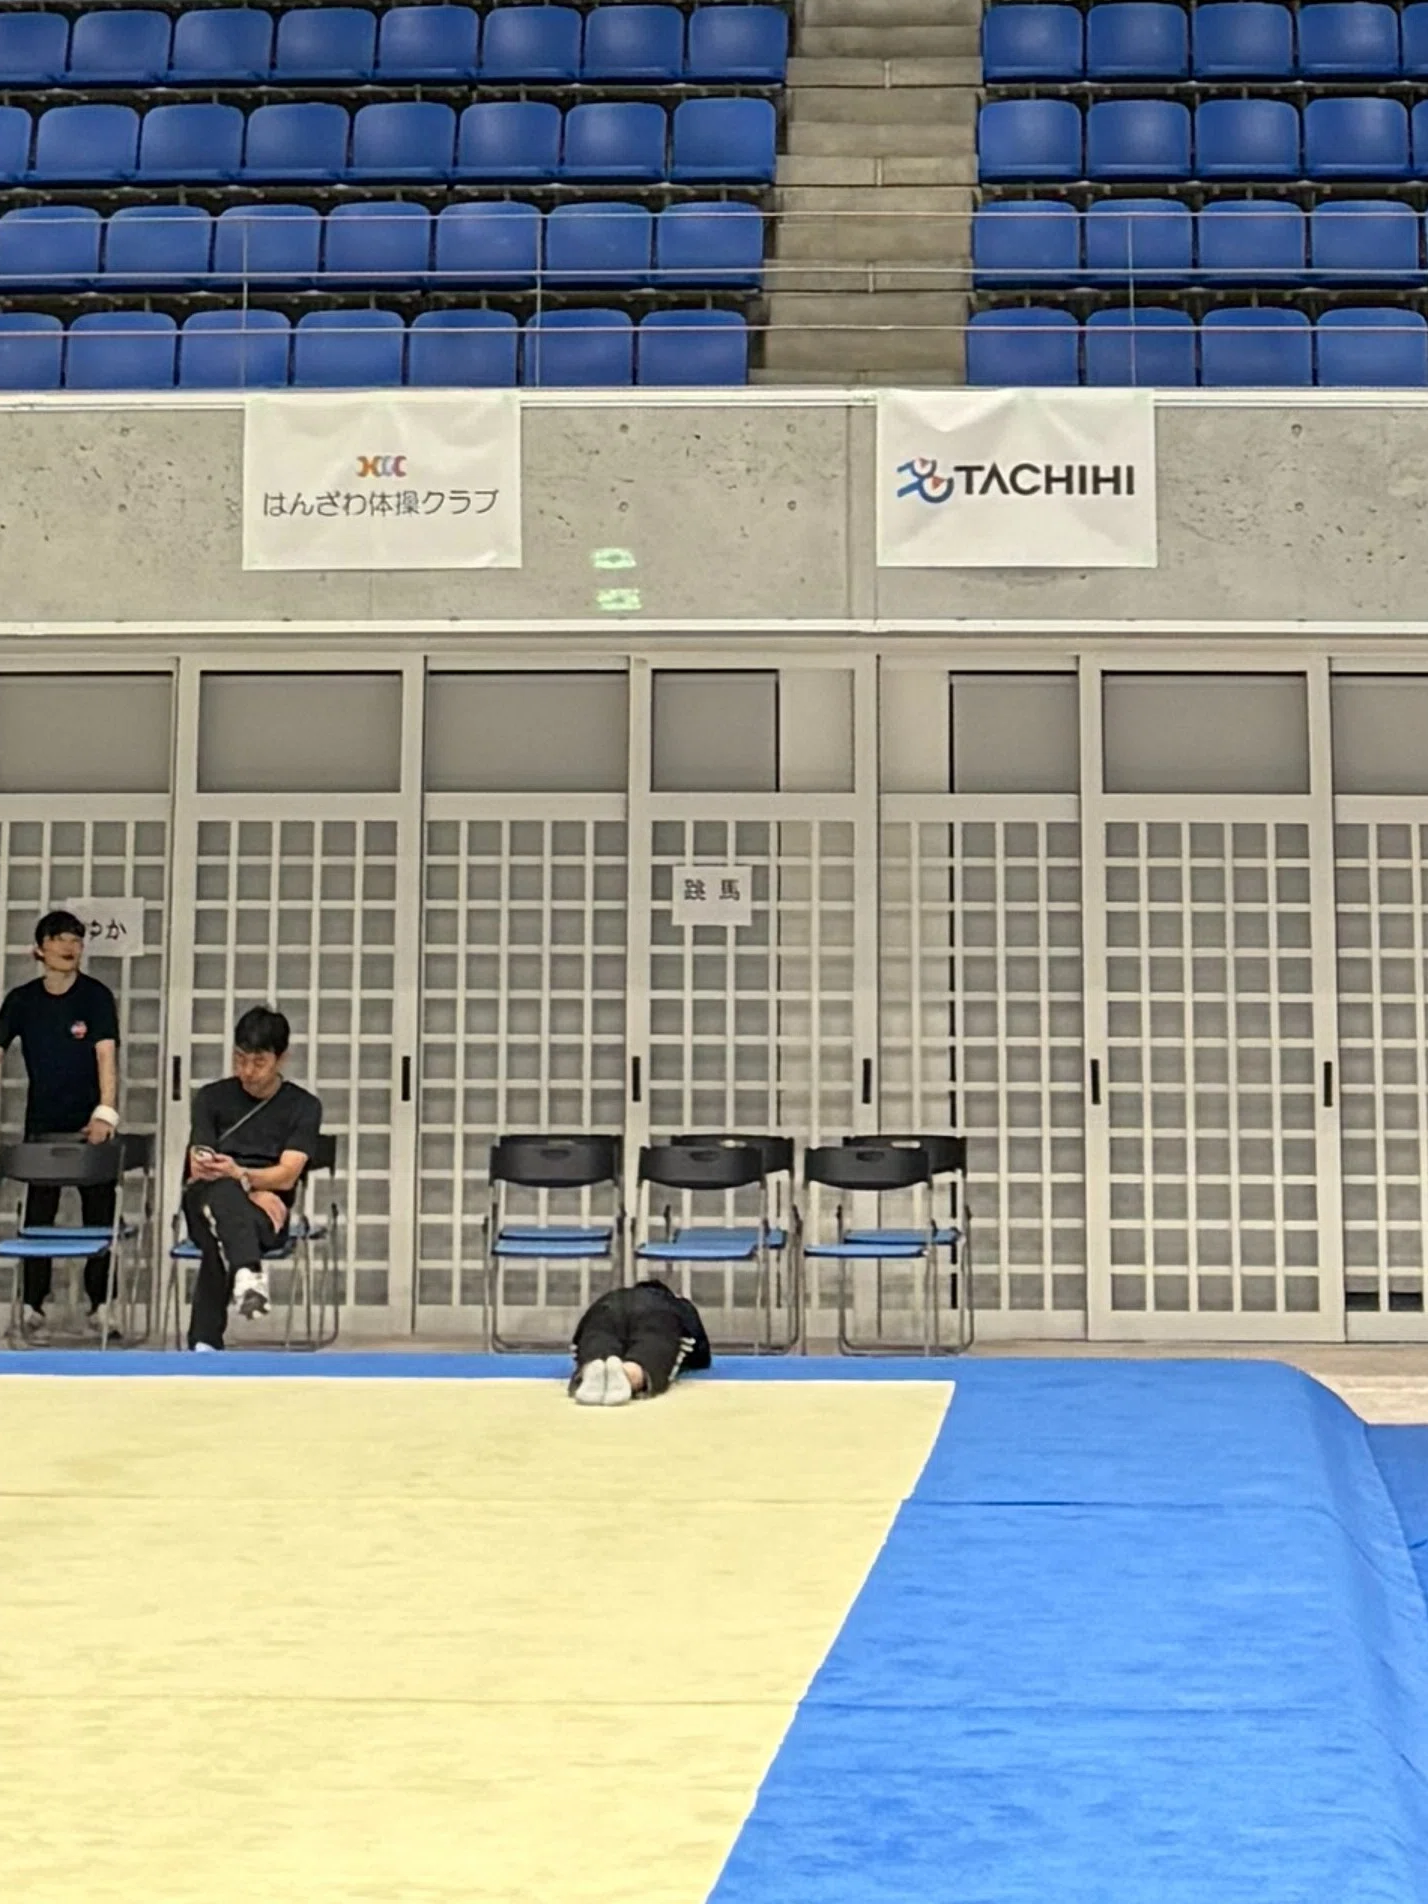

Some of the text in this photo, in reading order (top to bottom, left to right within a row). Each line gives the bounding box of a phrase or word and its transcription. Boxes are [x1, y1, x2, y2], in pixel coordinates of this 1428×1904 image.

[953, 461, 1136, 496] TACHIHI
[263, 489, 500, 518] はんざわ体操クラブ
